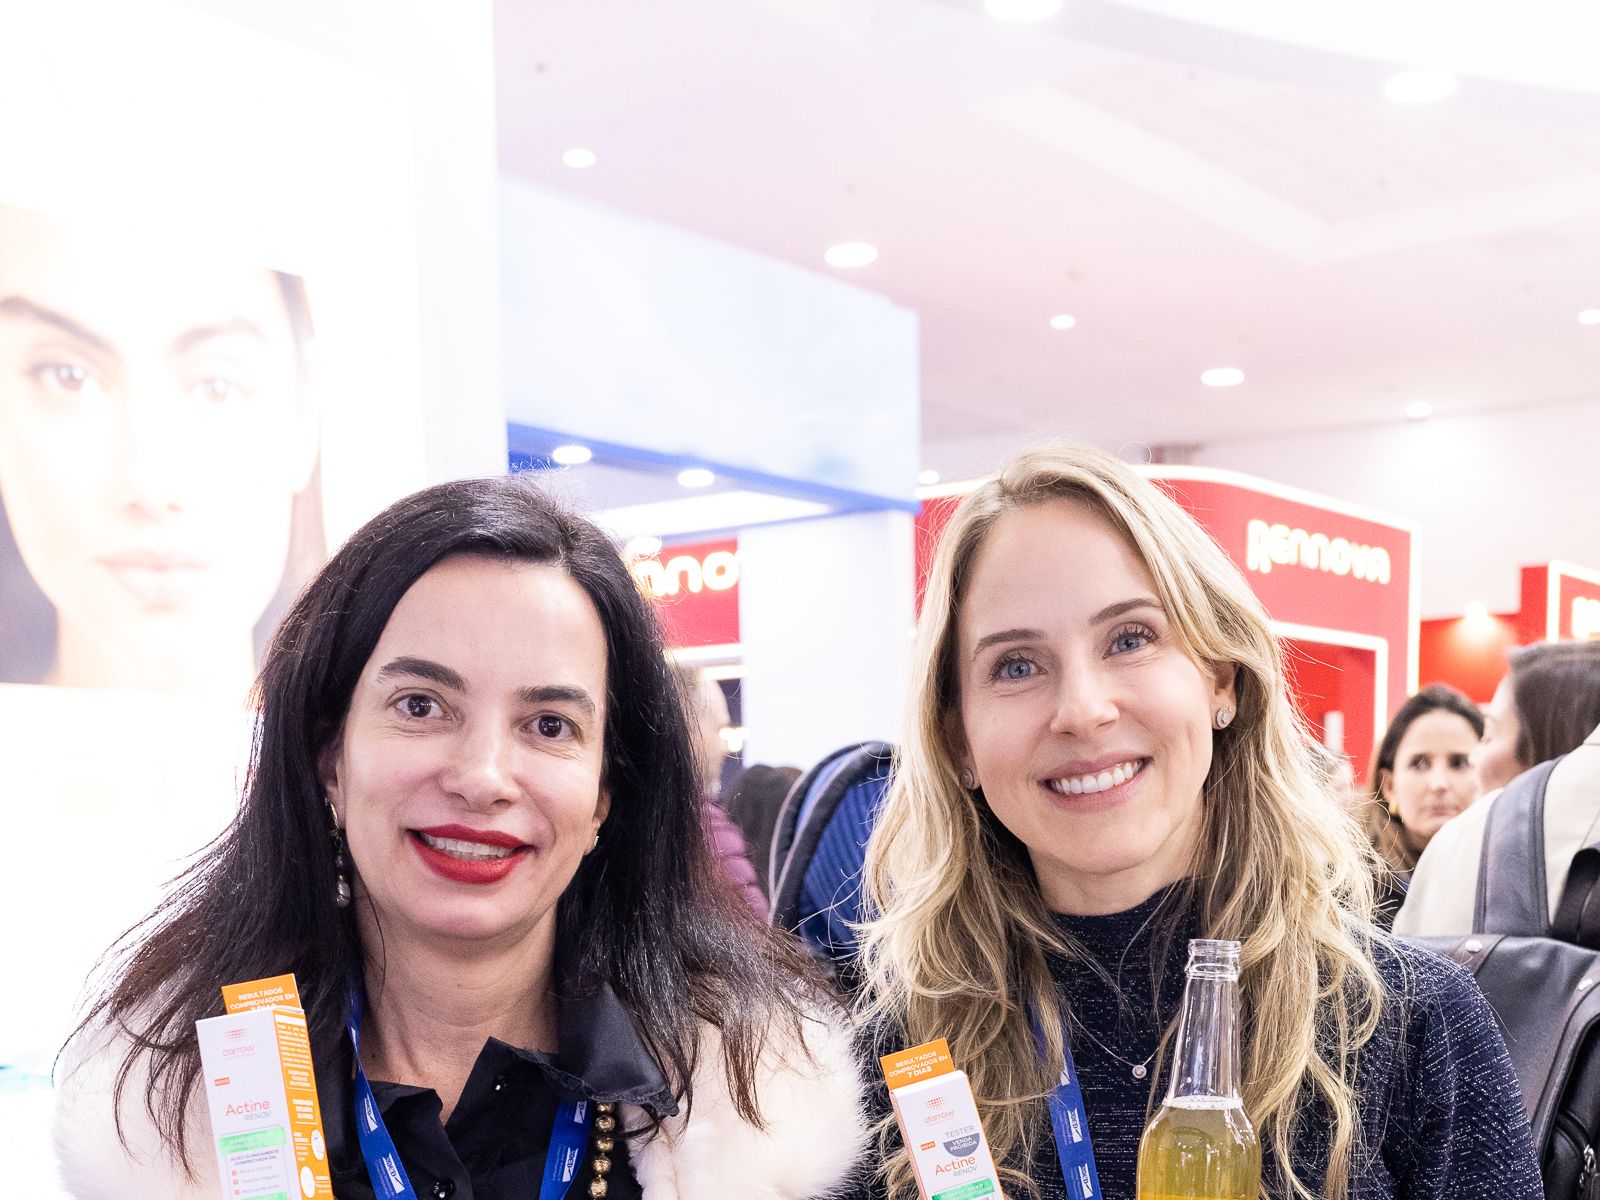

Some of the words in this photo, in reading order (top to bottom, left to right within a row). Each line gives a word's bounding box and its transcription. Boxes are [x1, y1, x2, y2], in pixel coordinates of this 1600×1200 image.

[889, 1058, 939, 1077] COMPROVADOS
[938, 1055, 948, 1064] EM
[895, 1051, 937, 1068] RESULTADOS
[907, 1070, 913, 1078] 7
[913, 1066, 933, 1076] DIAS
[225, 1100, 271, 1117] Actine
[924, 1109, 954, 1124] darrow
[945, 1125, 975, 1138] TESTER
[952, 1136, 973, 1146] VENDA
[935, 1156, 976, 1176] Actine
[953, 1164, 978, 1178] RENOV
